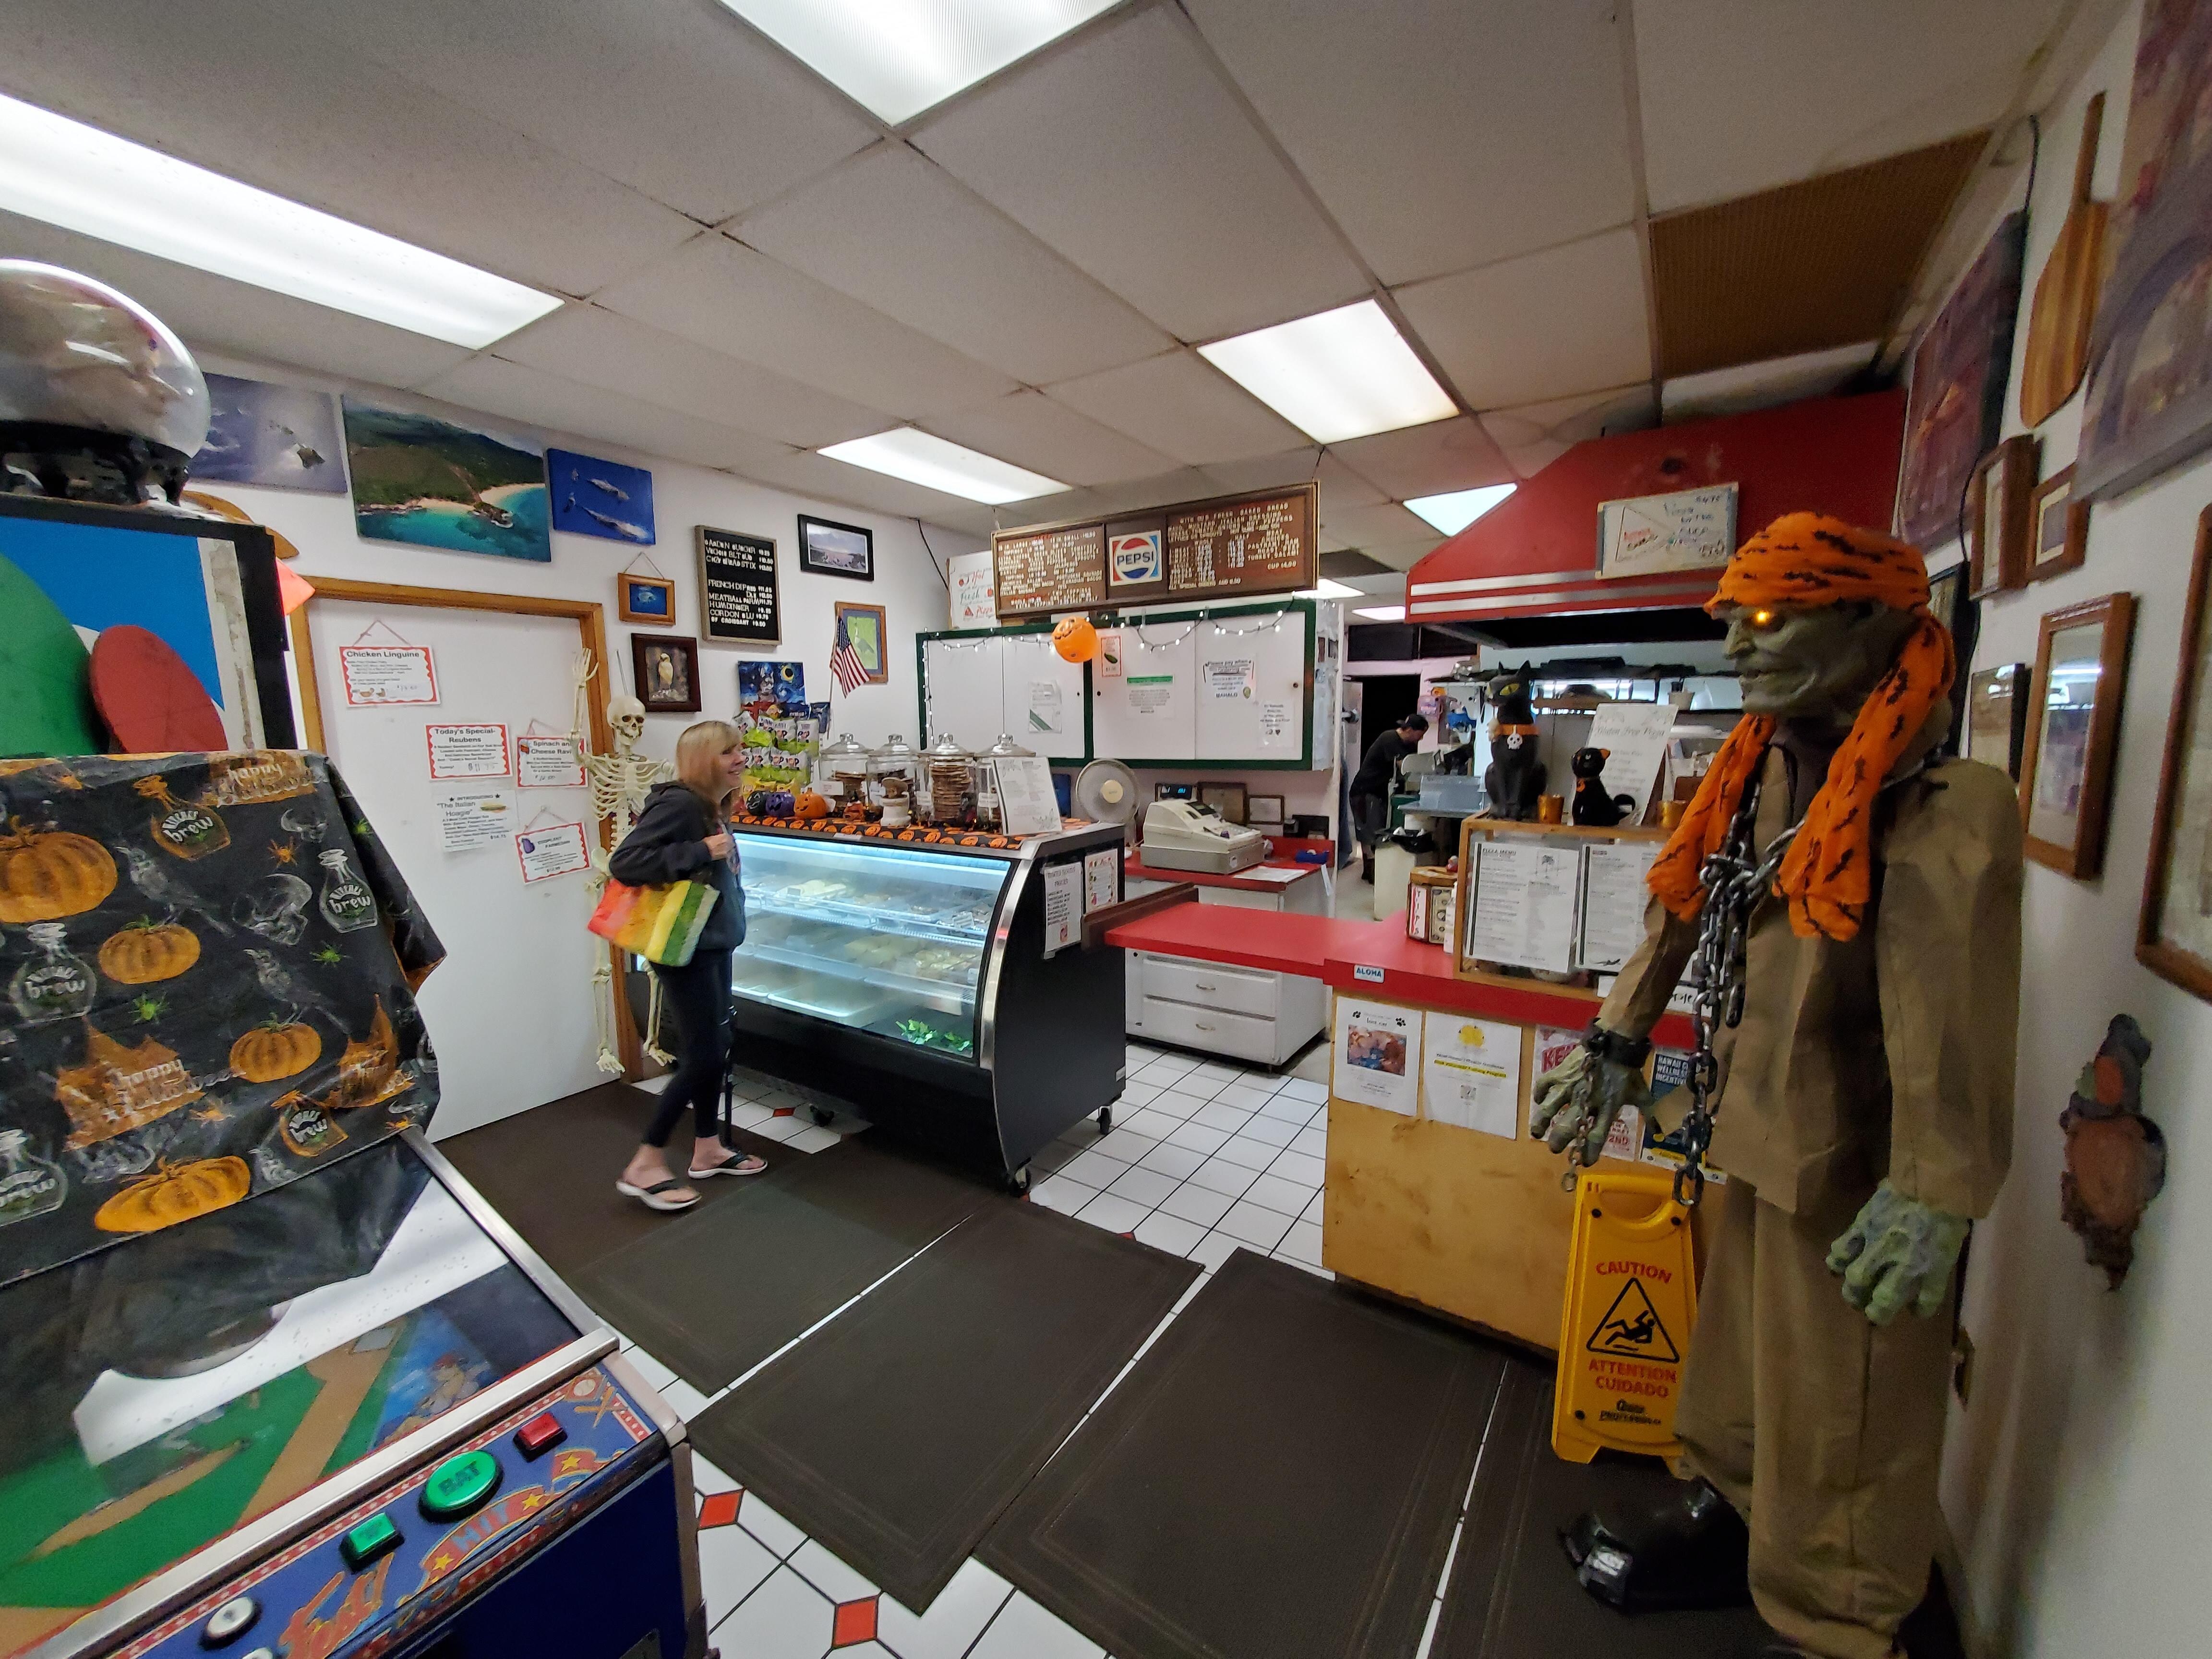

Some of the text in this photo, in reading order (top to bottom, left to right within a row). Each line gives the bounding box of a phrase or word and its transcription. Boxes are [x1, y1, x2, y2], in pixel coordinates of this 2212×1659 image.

[729, 551, 741, 559] BLT
[1117, 551, 1154, 566] PEPSI
[708, 579, 734, 589] FRENCH
[735, 582, 747, 590] DIP
[709, 592, 742, 603] MEATBALL
[709, 601, 749, 612] HUMDINGER
[710, 609, 739, 618] CORDON
[163, 817, 213, 843] brew
[328, 896, 371, 914] brew
[1356, 966, 1382, 978] ALOHA
[1596, 1261, 1672, 1284] CAUTION
[1588, 1359, 1677, 1384] ATTENTION
[1595, 1375, 1670, 1398] CUIDADO
[437, 1460, 481, 1497] BAT
